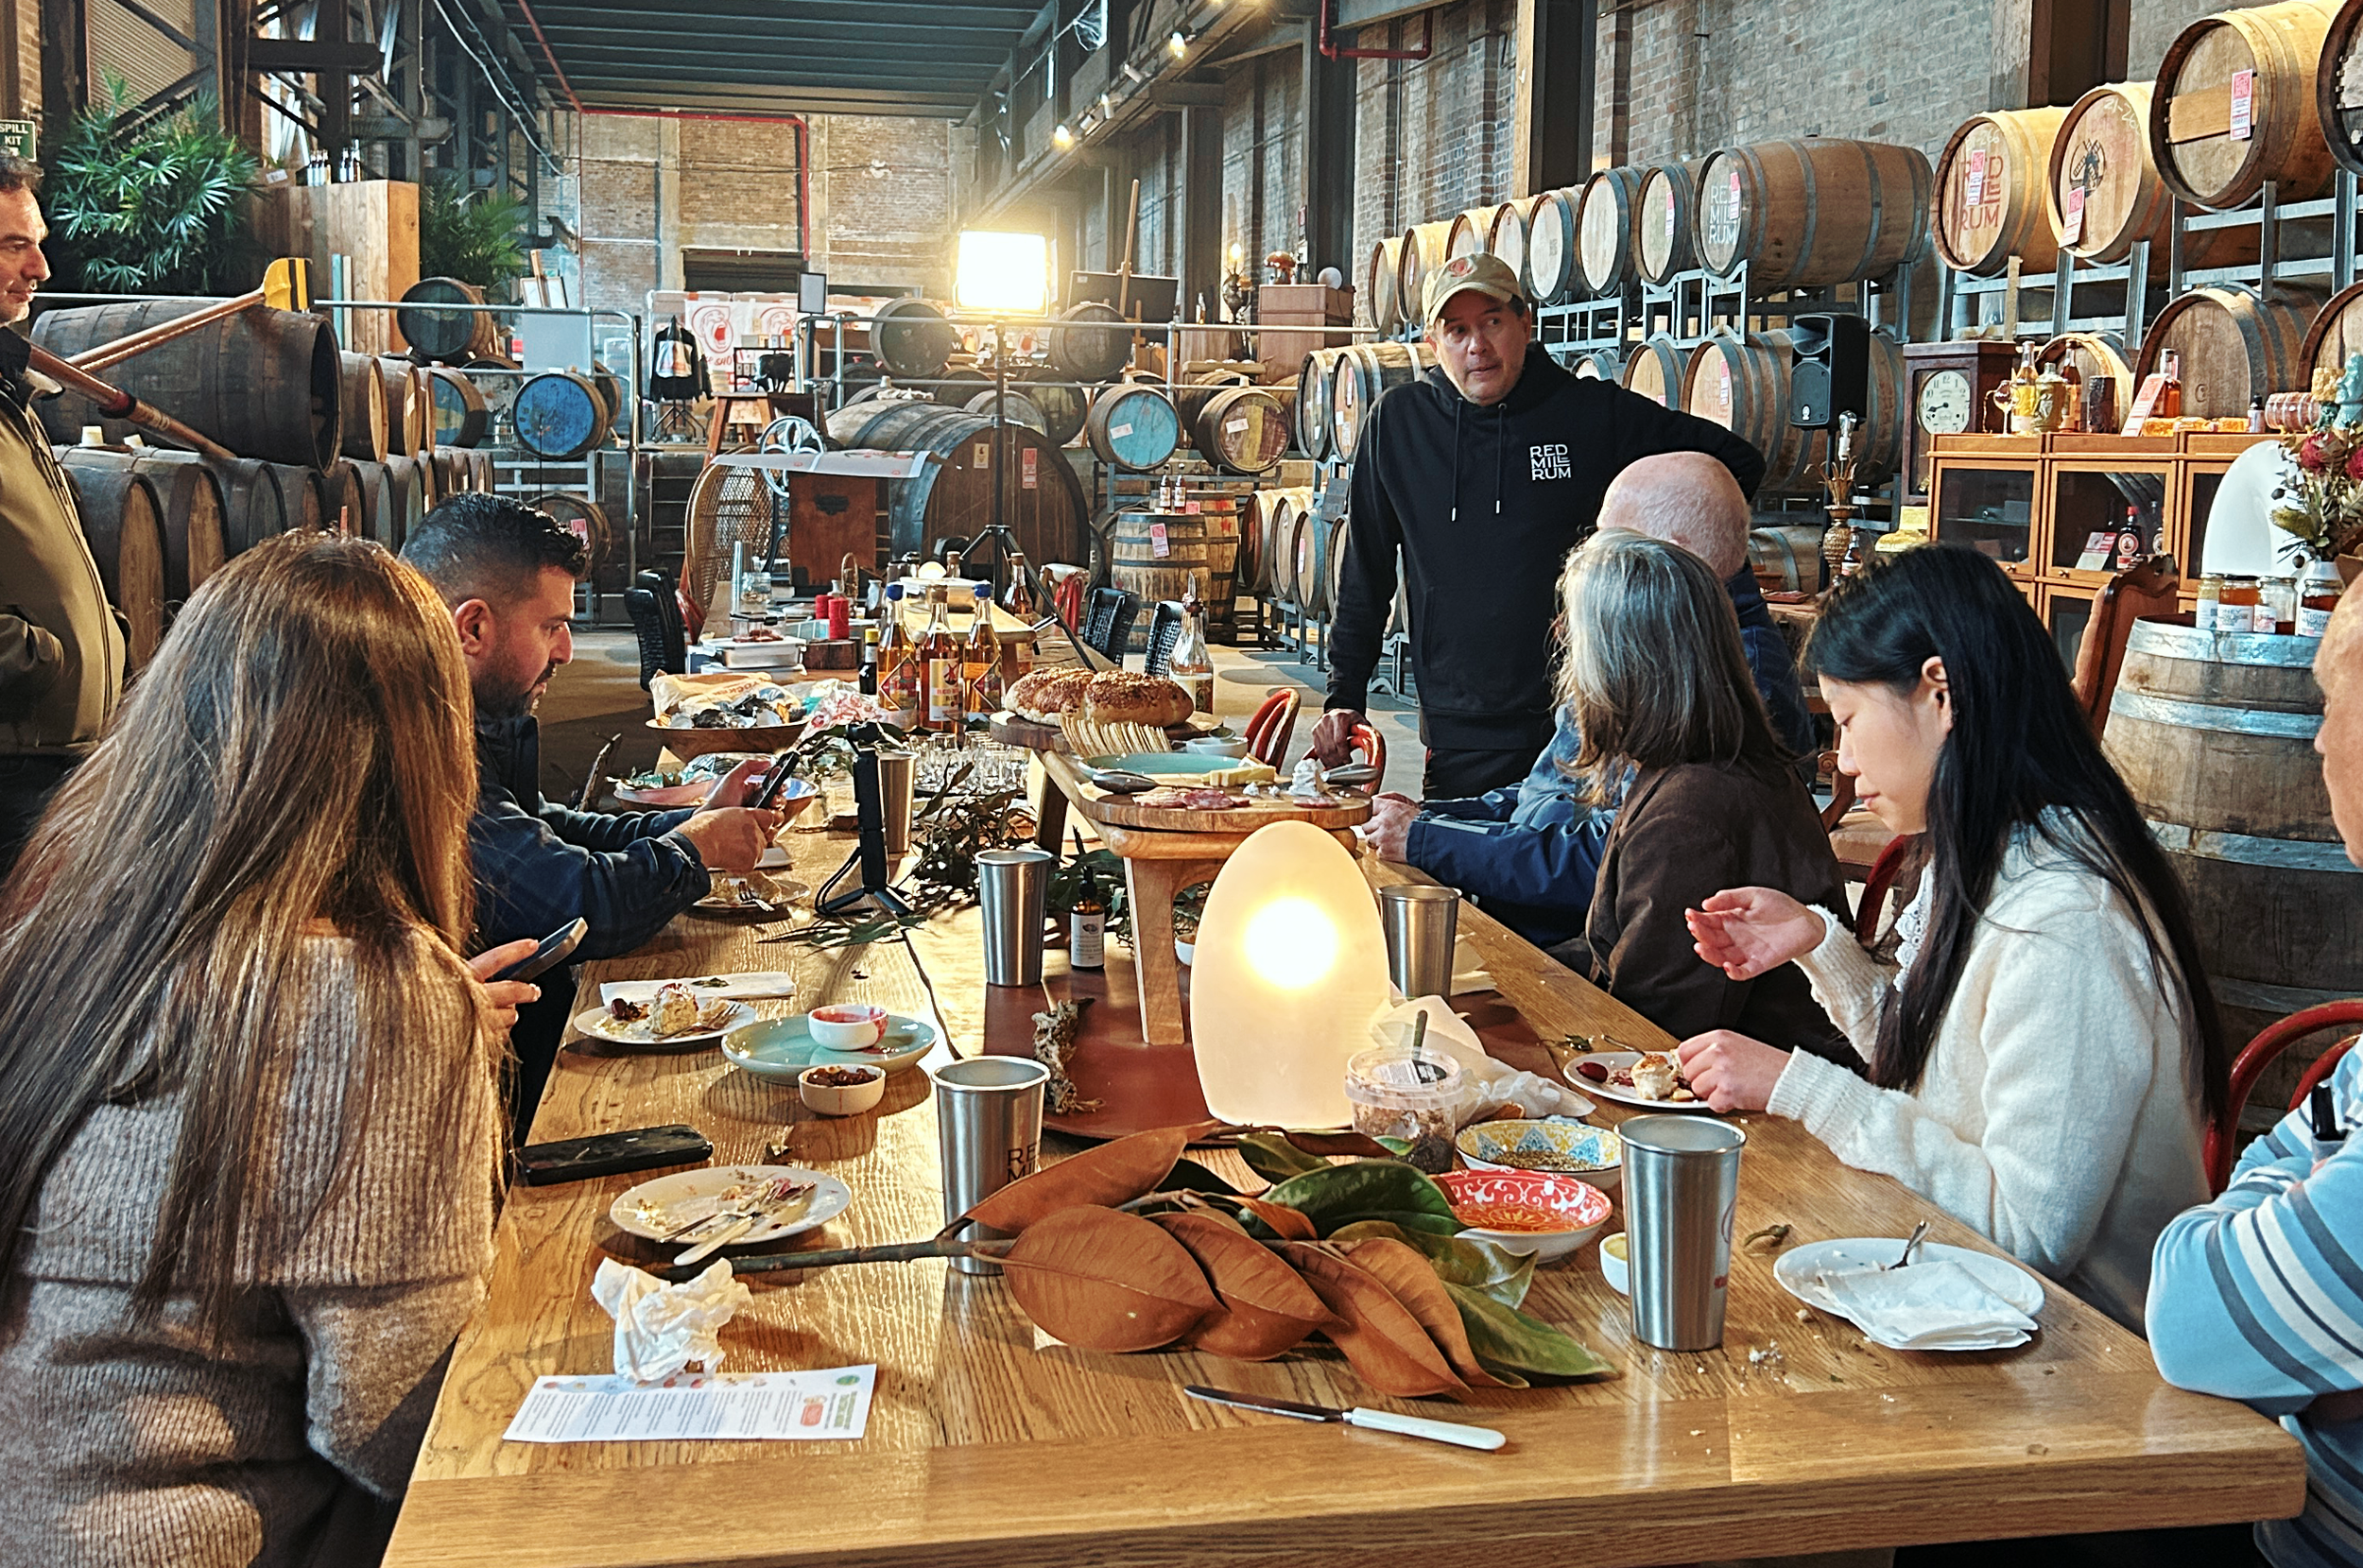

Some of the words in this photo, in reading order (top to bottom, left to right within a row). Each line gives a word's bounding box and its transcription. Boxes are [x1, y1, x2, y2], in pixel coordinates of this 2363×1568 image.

[0, 123, 28, 134] SPILL
[5, 135, 22, 146] KIT
[1959, 155, 2004, 181] RD
[1710, 204, 1736, 224] MIL
[1961, 204, 1999, 231] RUM
[1709, 224, 1737, 246] RUM
[1529, 443, 1569, 458] RED
[1531, 455, 1571, 470] MILL
[1531, 466, 1572, 481] RUM
